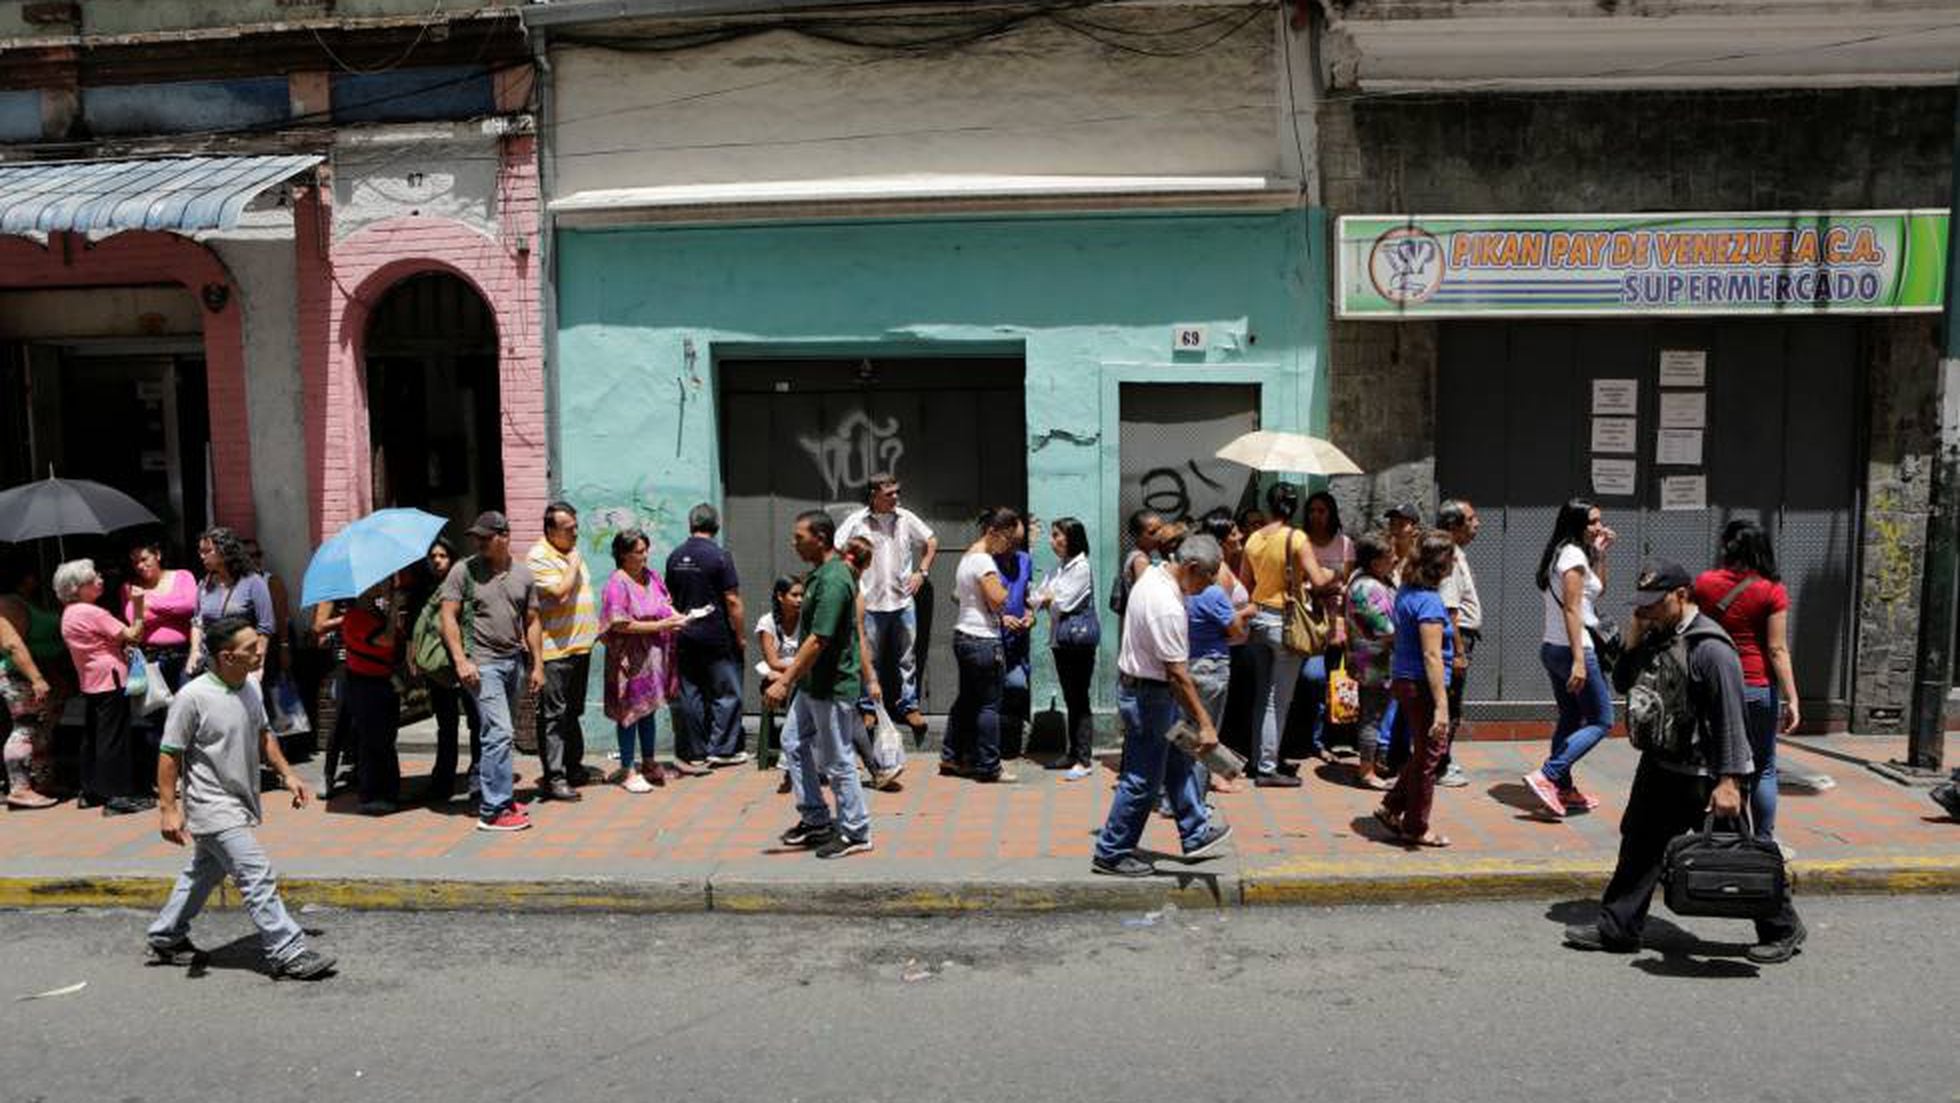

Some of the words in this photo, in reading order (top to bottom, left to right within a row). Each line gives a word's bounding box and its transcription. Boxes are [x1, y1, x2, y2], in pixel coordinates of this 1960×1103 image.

[1451, 232, 1544, 268] PIKAN
[1550, 232, 1608, 268] PAY
[1610, 231, 1650, 268] DE
[1655, 231, 1819, 267] VENEZUELA
[1825, 228, 1883, 266] C.A.
[1624, 273, 1880, 303] SUPERMERCADO
